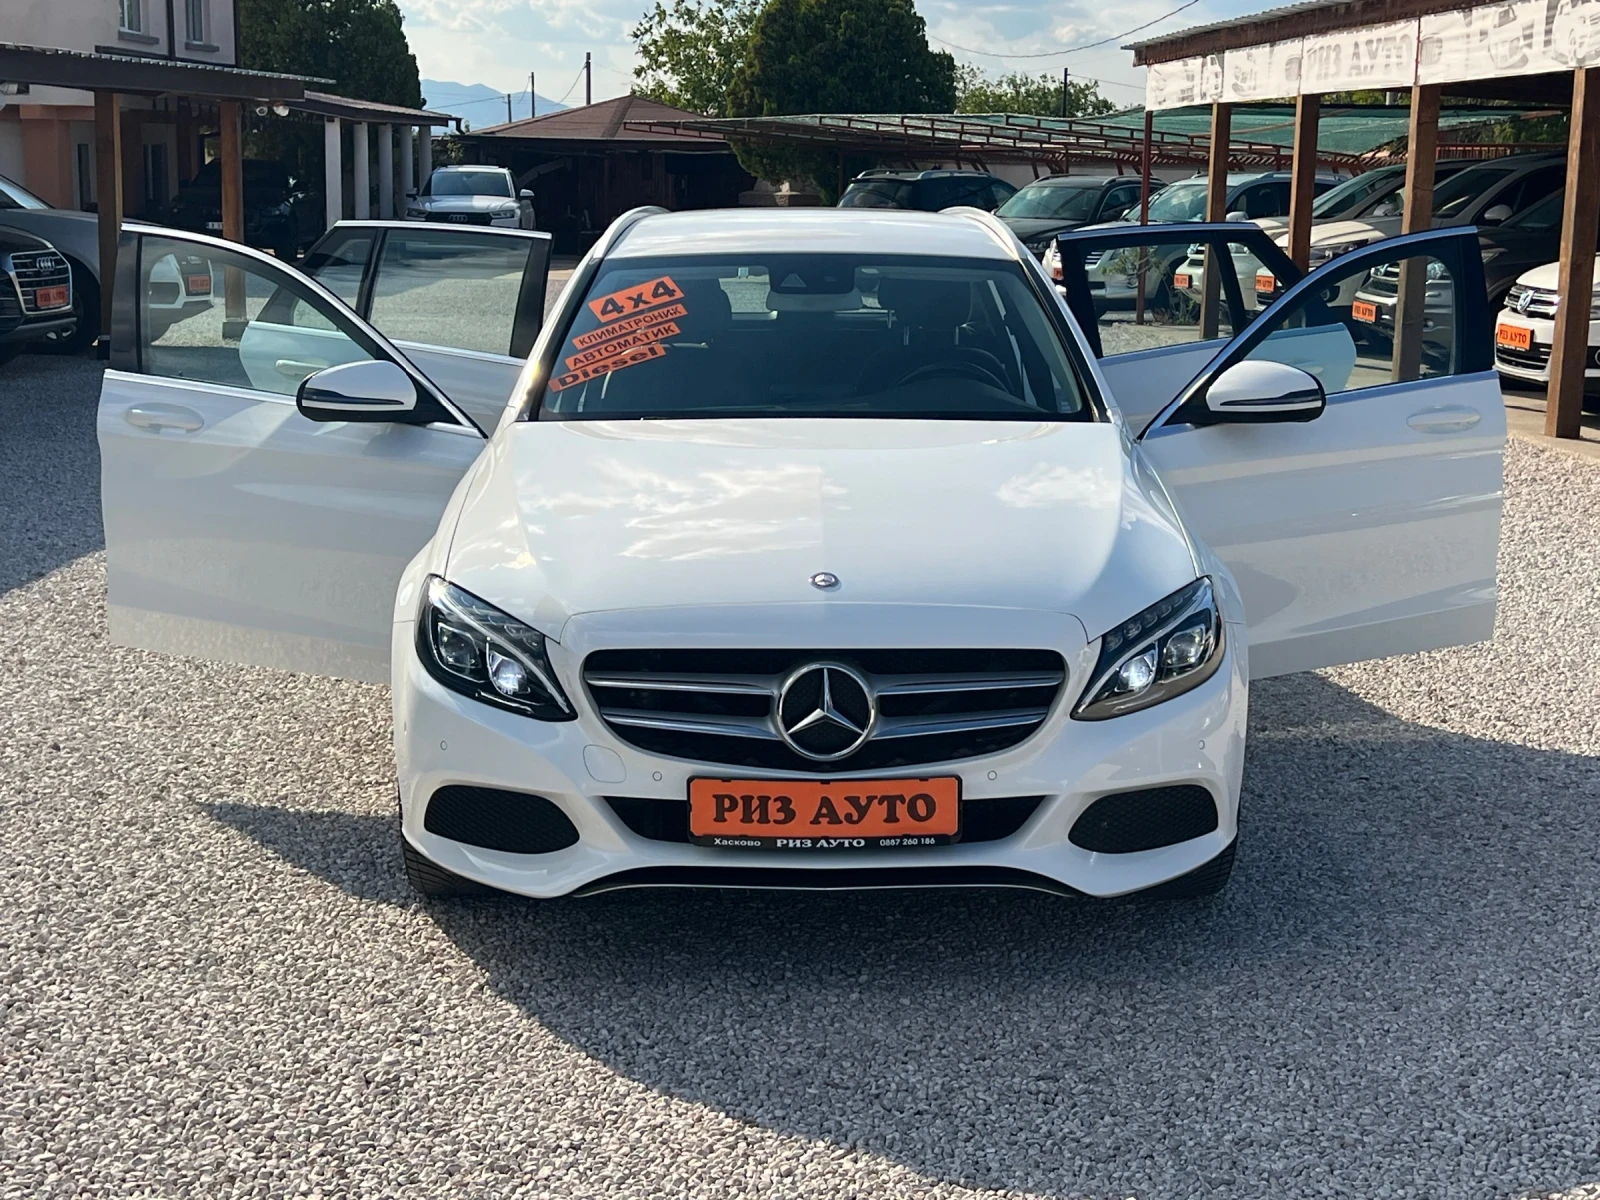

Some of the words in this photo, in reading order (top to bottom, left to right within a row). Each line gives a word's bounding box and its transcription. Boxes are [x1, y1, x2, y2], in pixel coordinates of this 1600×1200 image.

[600, 280, 677, 317] 4x4
[573, 324, 676, 367] АВТОМАТИК
[578, 307, 683, 346] КЛИМАТРОНИК
[558, 347, 659, 387] Diesel
[712, 794, 797, 825] РИЗ
[809, 793, 937, 825] АУТО
[714, 837, 761, 847] Хасково
[776, 838, 812, 848] РИЗ
[816, 838, 866, 848] АУТО
[879, 838, 900, 847] 0887
[920, 837, 935, 845] 186
